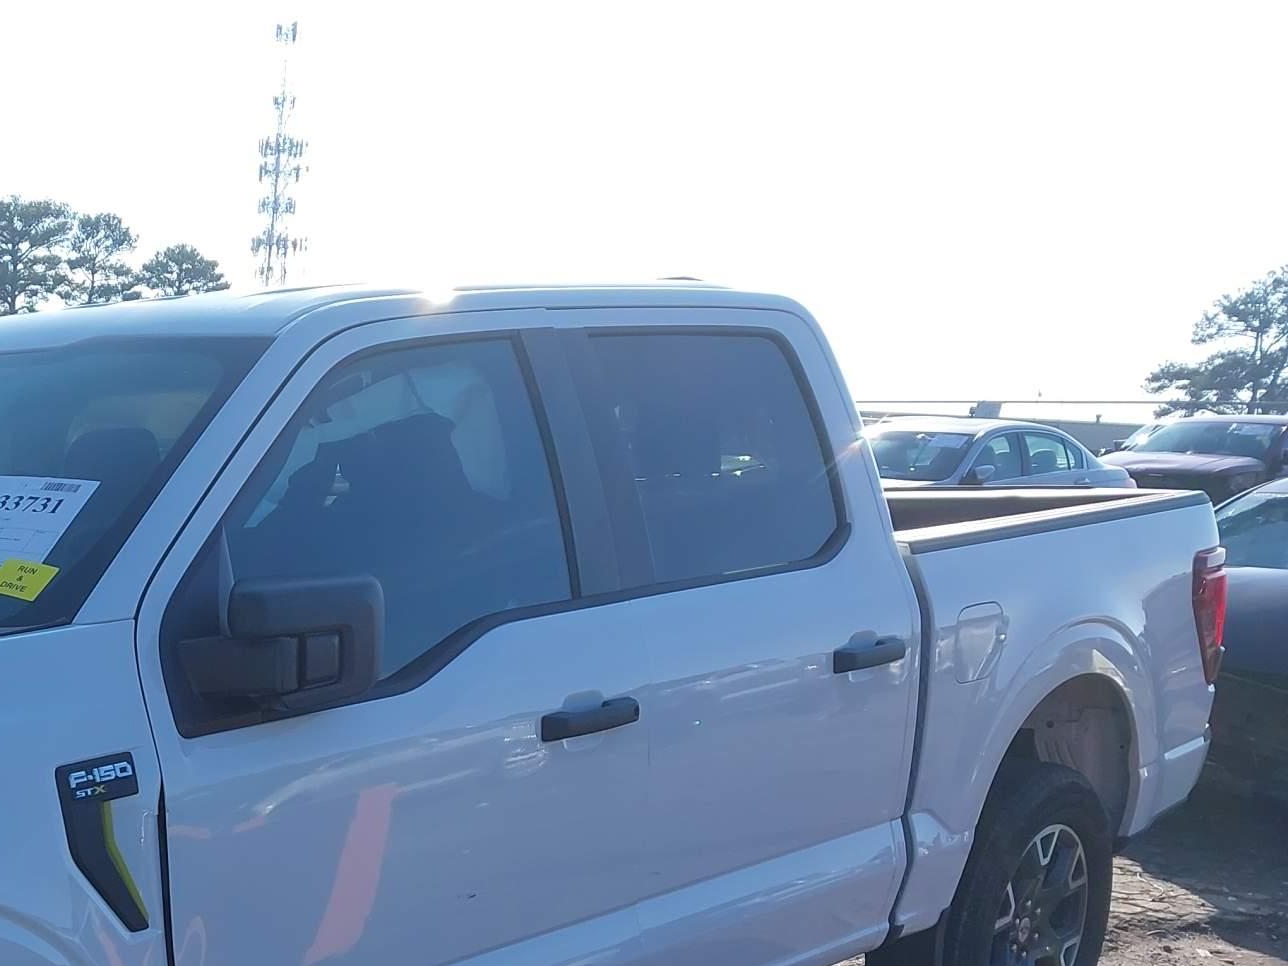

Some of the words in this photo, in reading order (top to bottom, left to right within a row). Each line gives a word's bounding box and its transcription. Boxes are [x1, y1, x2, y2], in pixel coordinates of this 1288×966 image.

[18, 565, 38, 575] RUN
[0, 581, 27, 593] DRIVE
[69, 761, 133, 789] F-150
[76, 785, 106, 798] STX
